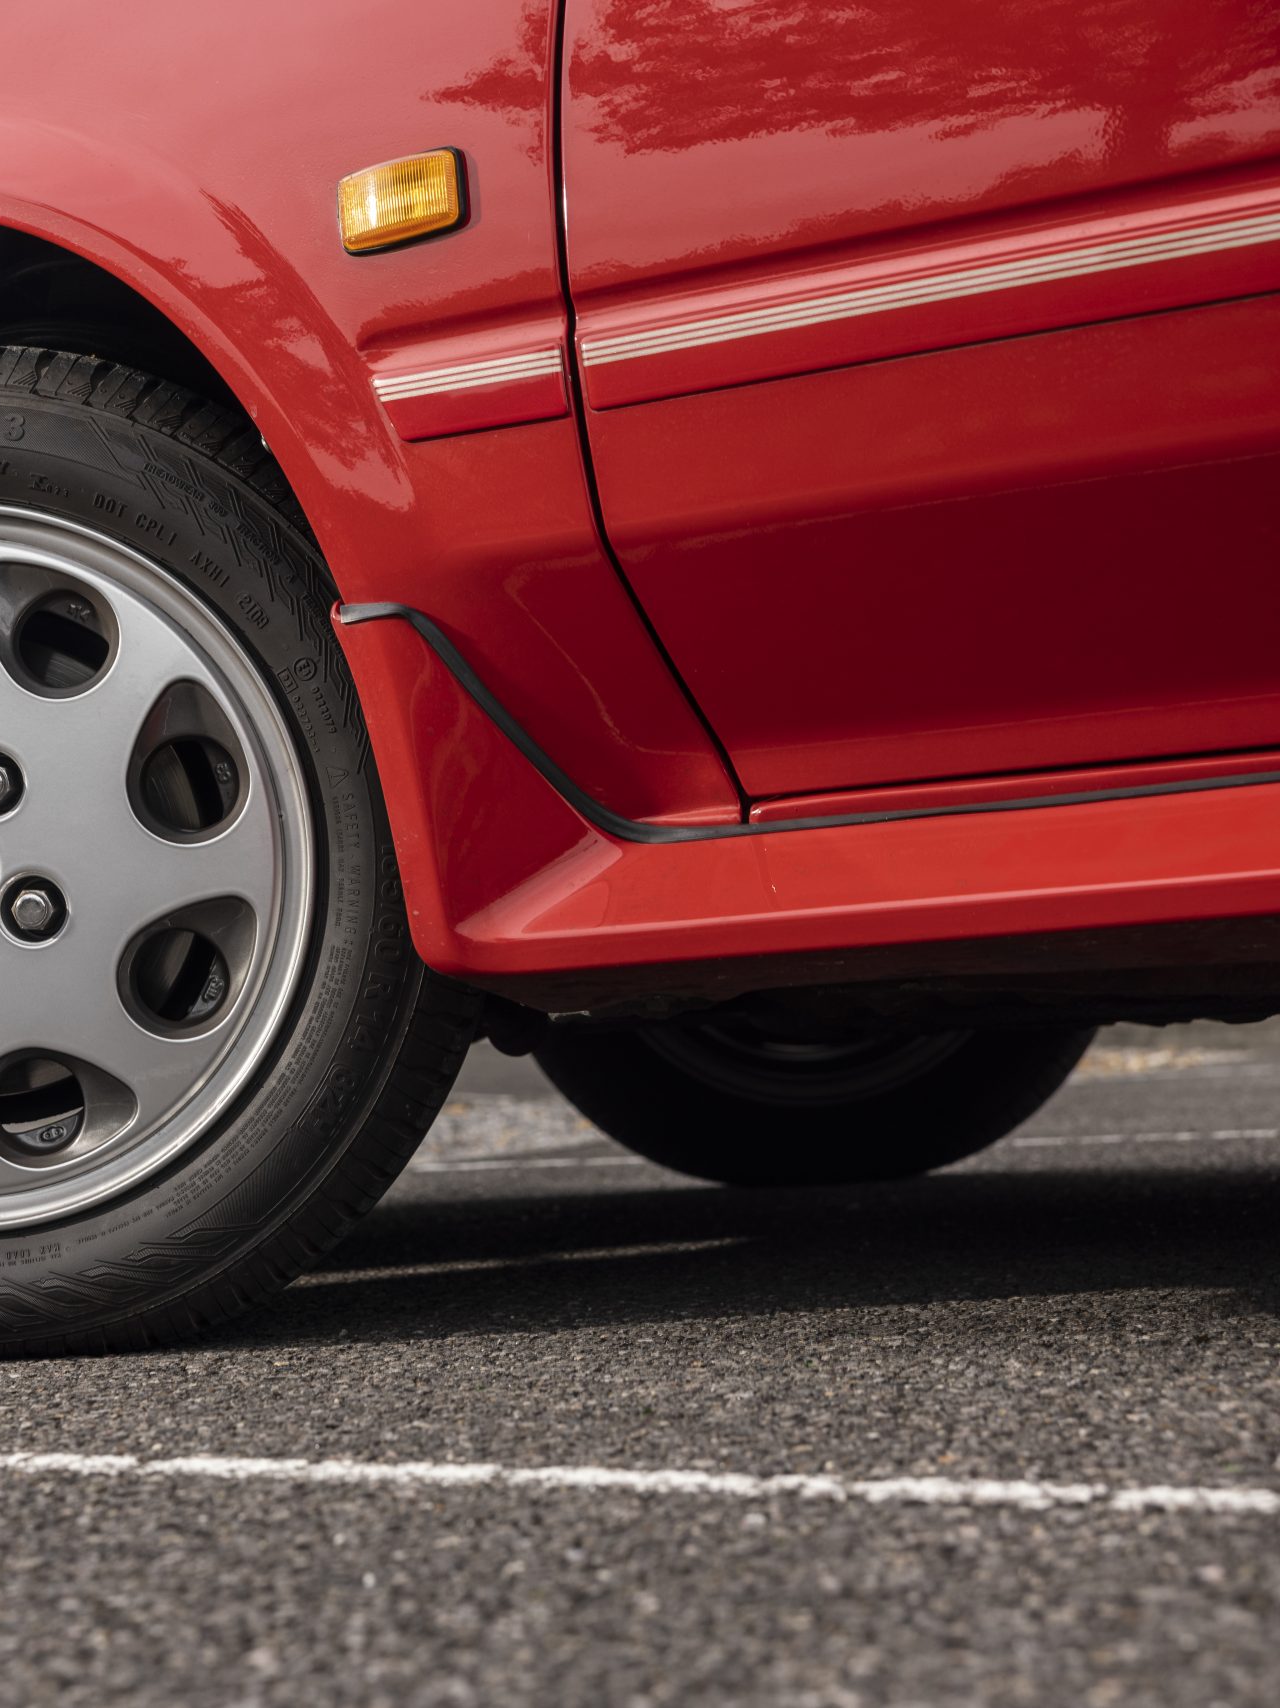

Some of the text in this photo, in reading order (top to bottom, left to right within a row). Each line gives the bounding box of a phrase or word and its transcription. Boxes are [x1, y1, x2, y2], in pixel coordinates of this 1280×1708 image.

[2, 412, 27, 442] 3
[90, 490, 128, 519] DOT
[341, 791, 359, 848] SAFETY
